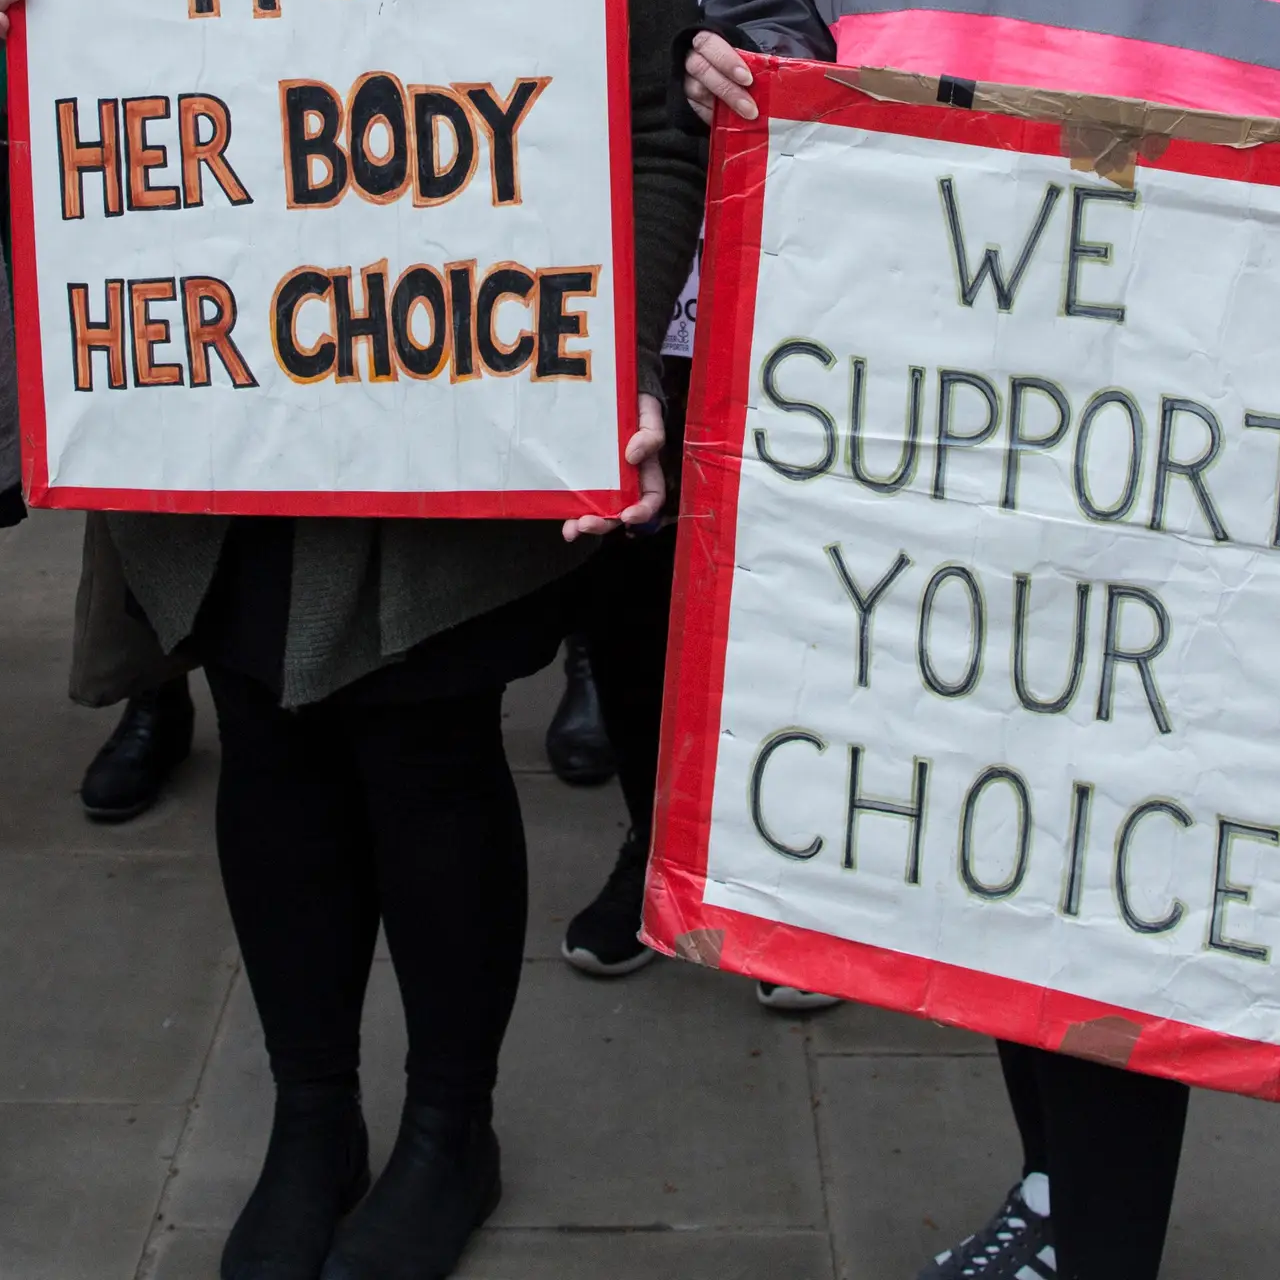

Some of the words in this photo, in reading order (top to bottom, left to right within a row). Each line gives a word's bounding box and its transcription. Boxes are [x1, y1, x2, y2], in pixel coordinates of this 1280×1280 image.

[56, 92, 254, 220] HER
[279, 71, 553, 210] BODY
[936, 174, 1140, 324] WE
[67, 276, 260, 391] HER
[270, 258, 603, 385] CHOICE
[825, 541, 1174, 736] YOUR
